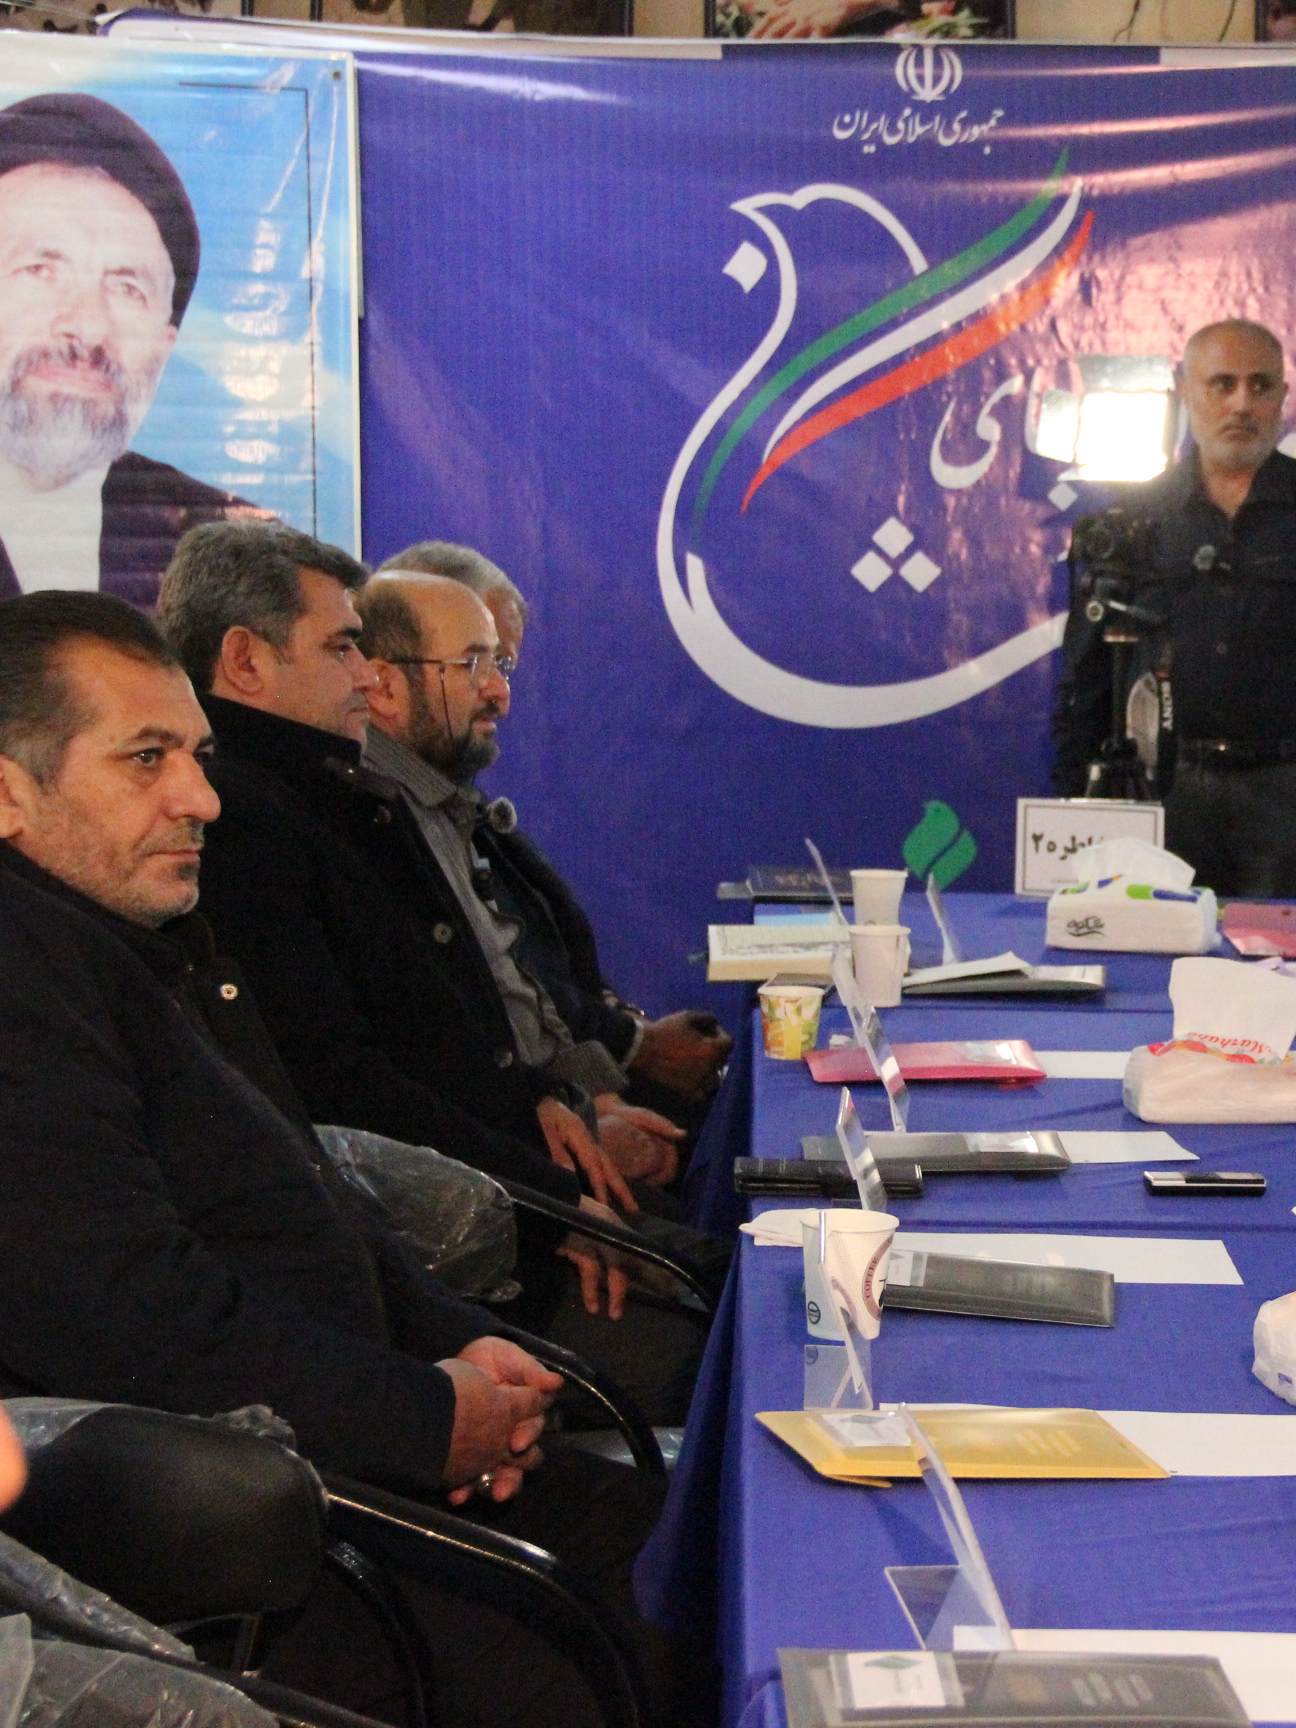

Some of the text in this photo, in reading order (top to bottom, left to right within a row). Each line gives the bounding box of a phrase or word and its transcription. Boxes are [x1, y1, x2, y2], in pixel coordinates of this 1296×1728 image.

[832, 107, 1005, 155] جمهوری اسلامی ایران
[1160, 680, 1174, 731] SONY
